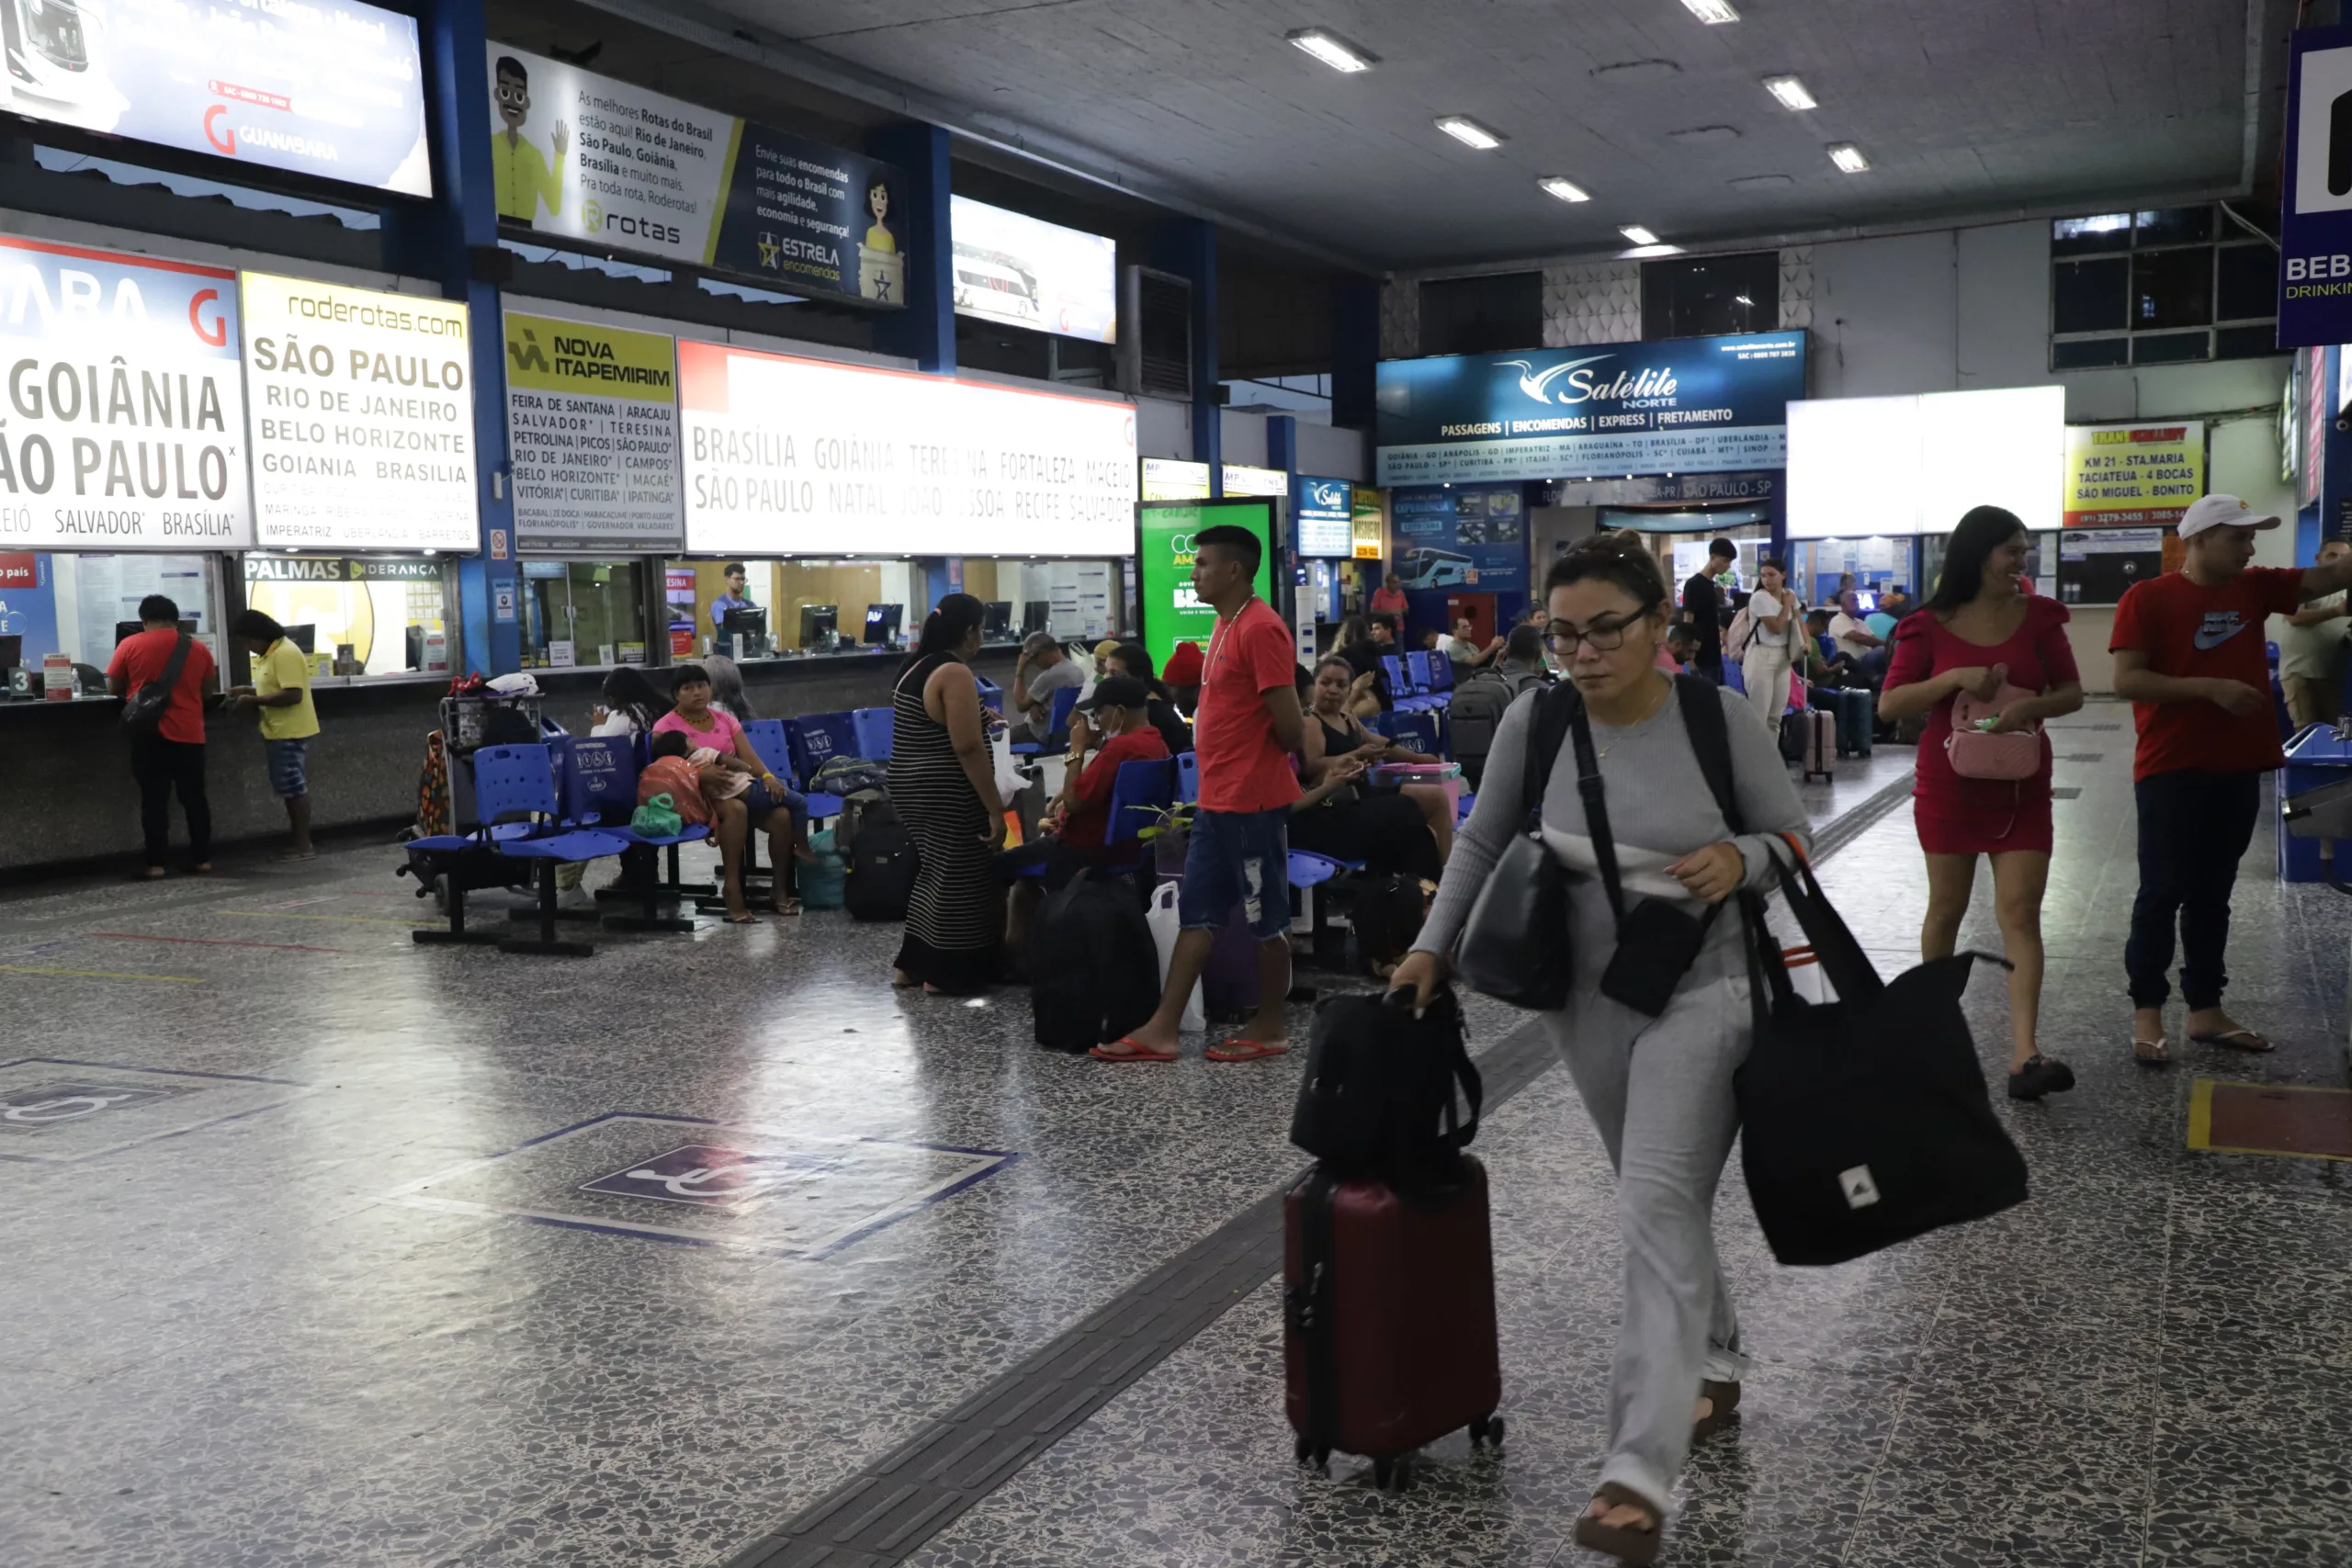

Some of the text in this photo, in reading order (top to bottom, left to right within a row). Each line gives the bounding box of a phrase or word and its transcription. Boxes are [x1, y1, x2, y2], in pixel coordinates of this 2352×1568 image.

[579, 90, 714, 141] As melhores Rotas do Brasil
[240, 125, 338, 162] GUANABARA
[579, 114, 707, 161] estão aqui! Rio de Janeiro,
[580, 132, 678, 172] São Paulo, Goiânia,
[755, 144, 849, 183] Envie suas encomendas
[580, 152, 684, 191] Brasília e muito mais.
[756, 167, 845, 200] para todo o Brasil com
[581, 175, 697, 214] Pra toda rota, Roderotas!
[756, 185, 818, 212] mais agilidade,
[607, 214, 680, 244] rotas
[757, 206, 850, 239] economia e segurança!
[783, 238, 840, 265] ESTRELA
[784, 260, 840, 281] encomendas
[2287, 254, 2350, 281] BEB
[288, 294, 462, 337] roderotas.com
[254, 333, 463, 390] SÃO PAULO
[555, 336, 615, 360] NOVA
[555, 358, 670, 387] ITAPEMIRIM
[1558, 367, 1678, 404] Satélite
[8, 355, 225, 432] GOIÂNIA
[267, 385, 457, 422] RIO DE JANEIRO
[1623, 398, 1678, 409] NORTE
[512, 395, 671, 421] FEIRA DE SANTANA ARACAJU
[610, 422, 672, 437] TERESINA
[1442, 409, 1733, 435] PASSAGENS ENCOMENDAS EXPRESS FRETAMENTO
[262, 419, 465, 453] BELO HORIZONTE
[514, 432, 573, 447] PETROLINA
[581, 436, 610, 450] PICOS
[616, 436, 638, 451] SÃO
[1506, 445, 1551, 455] IMPERATRIZ
[1651, 437, 1686, 447] BRASÍLIA
[1718, 434, 1769, 444] UBERLÂNDIA
[515, 449, 537, 463] RIO
[541, 452, 556, 464] DE
[694, 423, 796, 468] BRASÍLIA
[1001, 451, 1075, 484] FORTALEZA
[1406, 461, 1429, 469] PAULO
[1460, 458, 1493, 468] CURITIBA
[1582, 450, 1643, 460] FLORIANÓPOLIS
[2085, 453, 2185, 468] KM 21 STA.MARIA
[516, 468, 545, 480] BELO
[2079, 468, 2194, 483] TACIATEUA 4 BOCAS
[695, 468, 738, 512] SÃO
[746, 477, 813, 513] PAULO
[830, 482, 887, 516] NATAL
[1016, 491, 1060, 521] RECIFE
[1710, 481, 1771, 496] PAULO SP
[2076, 484, 2194, 499] SÃO MIGUEL BONITO
[518, 509, 548, 518] BACABAL
[587, 520, 634, 530] GOVERNADOR
[266, 525, 332, 537] IMPERATRIZ
[419, 528, 470, 541] BARRETOS
[6, 567, 28, 578] país
[244, 560, 340, 579] PALMAS
[15, 671, 28, 691] 3
